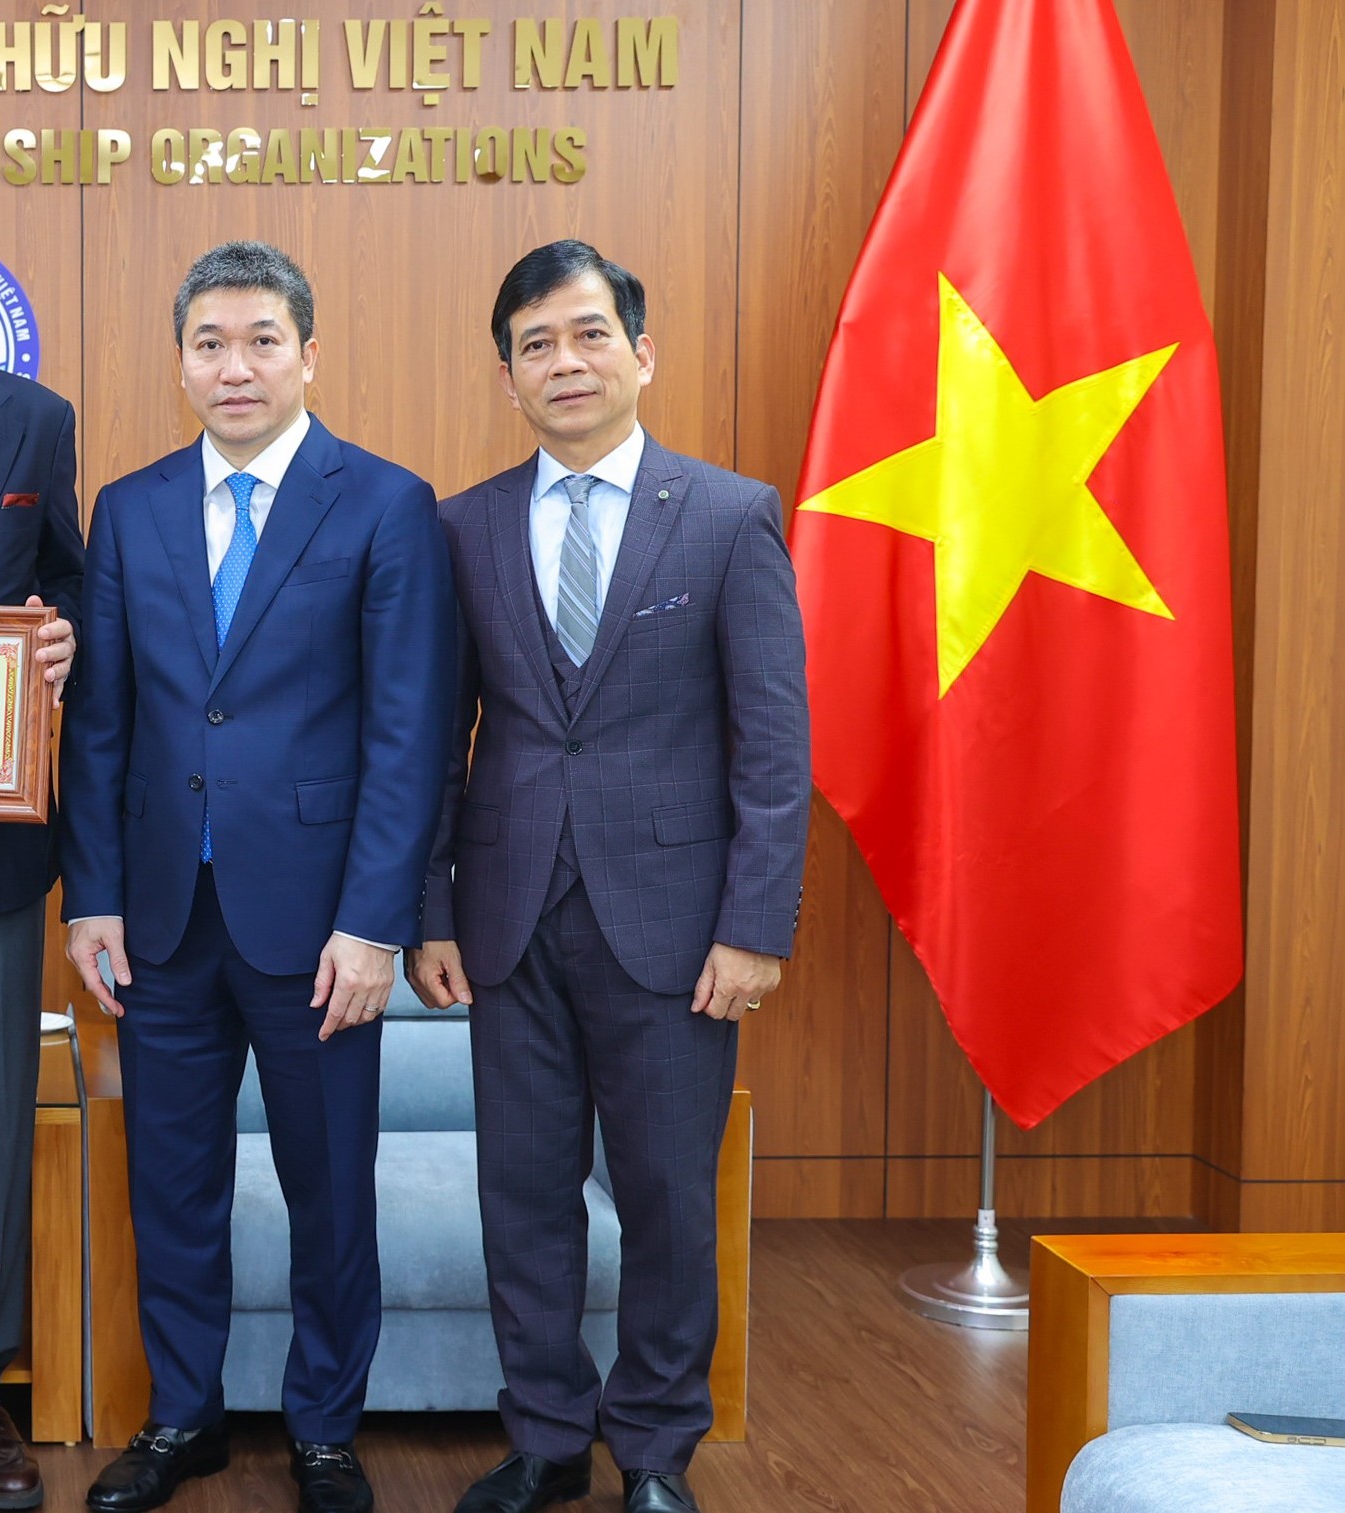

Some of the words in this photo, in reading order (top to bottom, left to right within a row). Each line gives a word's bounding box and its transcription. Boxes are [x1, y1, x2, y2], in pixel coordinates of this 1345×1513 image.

[153, 18, 321, 105] NGHỊ
[344, 1, 491, 105] VIỆT
[513, 16, 680, 90] NAM
[151, 126, 588, 185] ORGANIZATIONS
[9, 305, 31, 342] NAM
